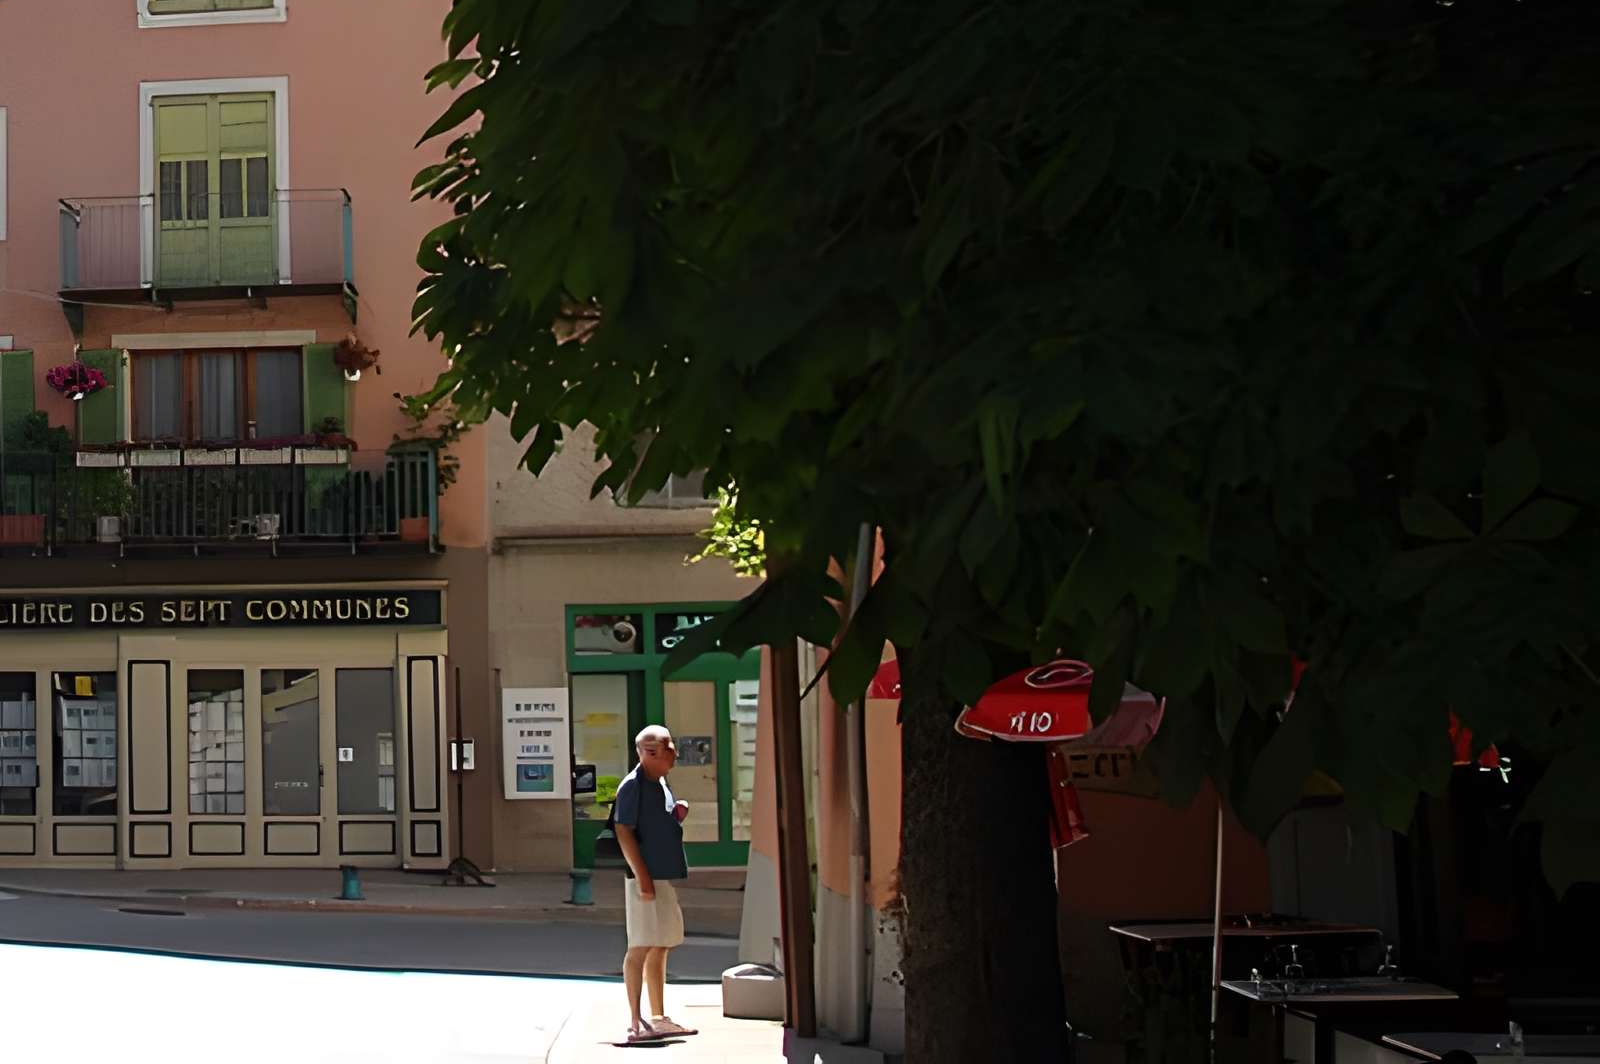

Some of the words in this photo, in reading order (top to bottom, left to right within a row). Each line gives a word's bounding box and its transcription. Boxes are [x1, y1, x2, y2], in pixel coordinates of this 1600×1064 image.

[90, 601, 145, 623] DES
[161, 600, 232, 622] SEPT
[246, 597, 410, 621] COMMUNES
